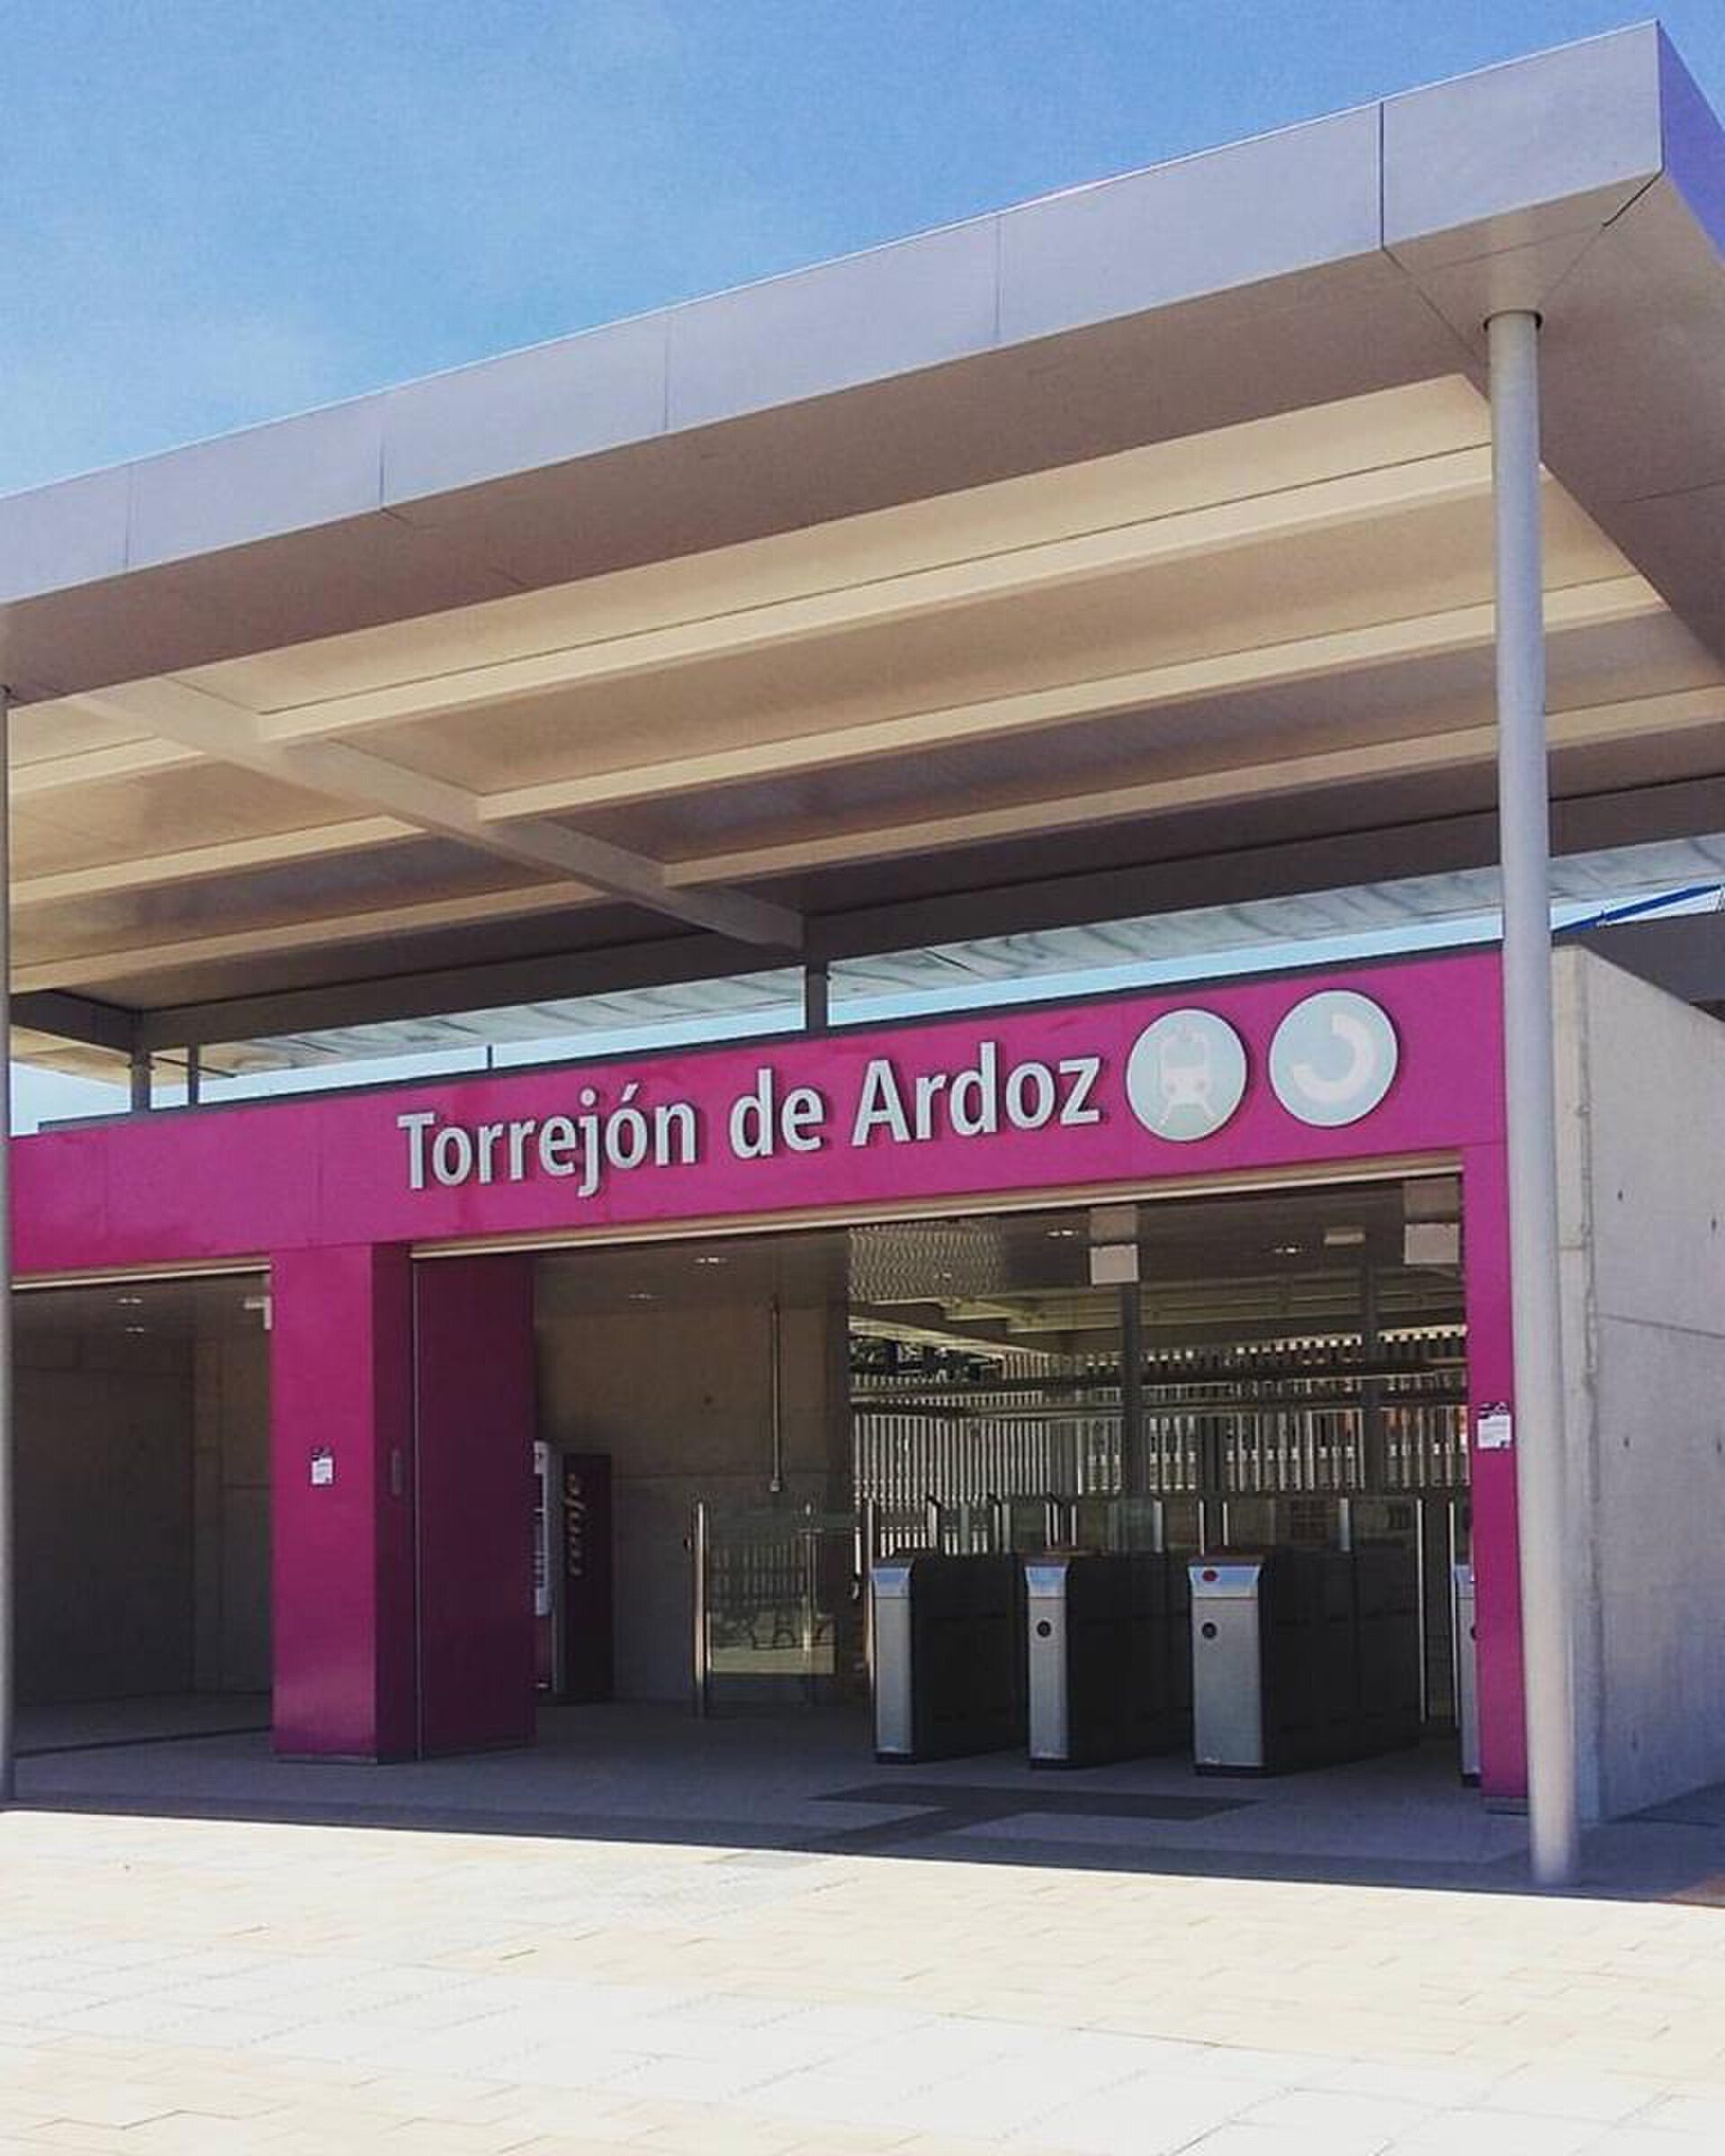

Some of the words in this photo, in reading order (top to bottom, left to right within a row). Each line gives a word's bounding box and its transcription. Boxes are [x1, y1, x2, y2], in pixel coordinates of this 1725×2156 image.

[396, 1082, 697, 1197] Torrejón
[729, 1066, 825, 1157] de
[851, 1040, 1101, 1147] Ardoz
